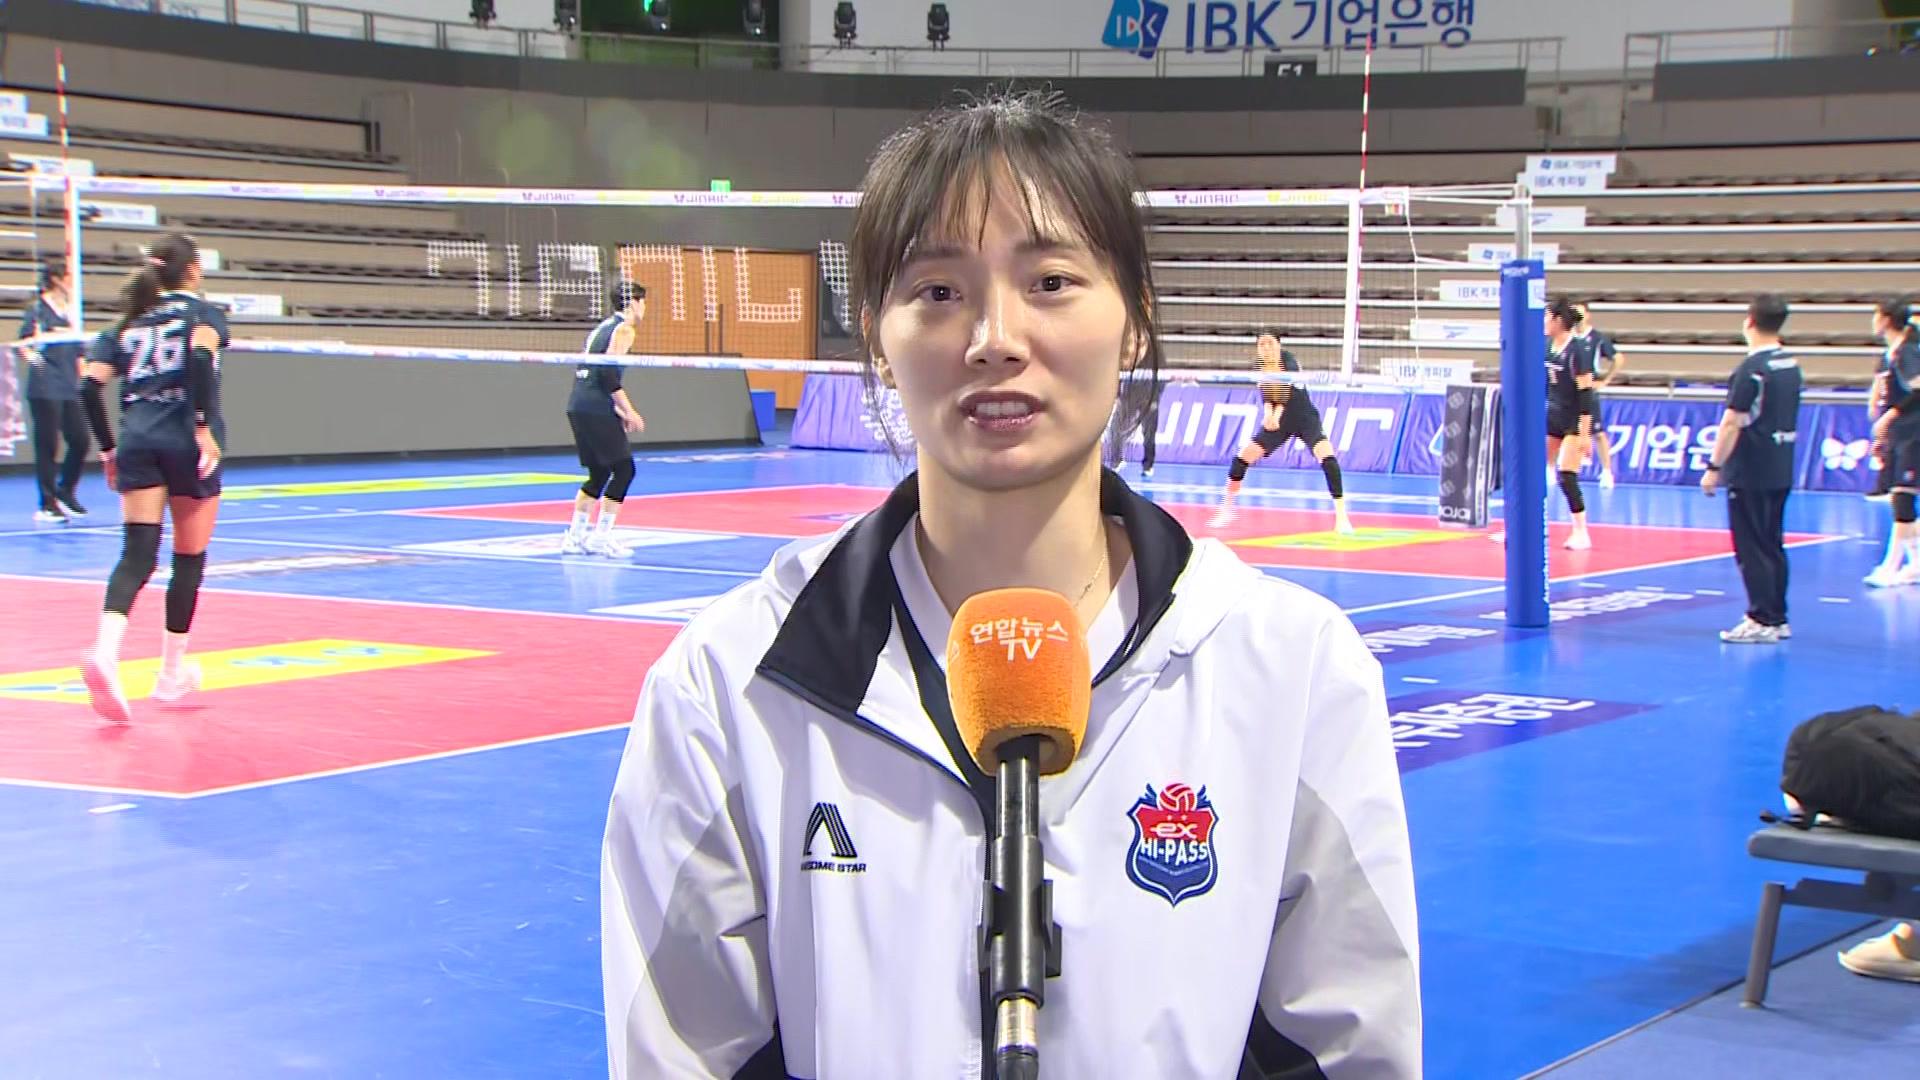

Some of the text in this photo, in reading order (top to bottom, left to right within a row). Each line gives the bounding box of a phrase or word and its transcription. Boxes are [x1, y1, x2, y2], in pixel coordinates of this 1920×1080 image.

[120, 320, 185, 378] 26
[1606, 424, 1722, 470] 기업은
[970, 617, 1069, 645] 연합뉴스
[999, 638, 1042, 661] TV
[1140, 838, 1208, 867] HI-PASS
[837, 863, 866, 872] STAR
